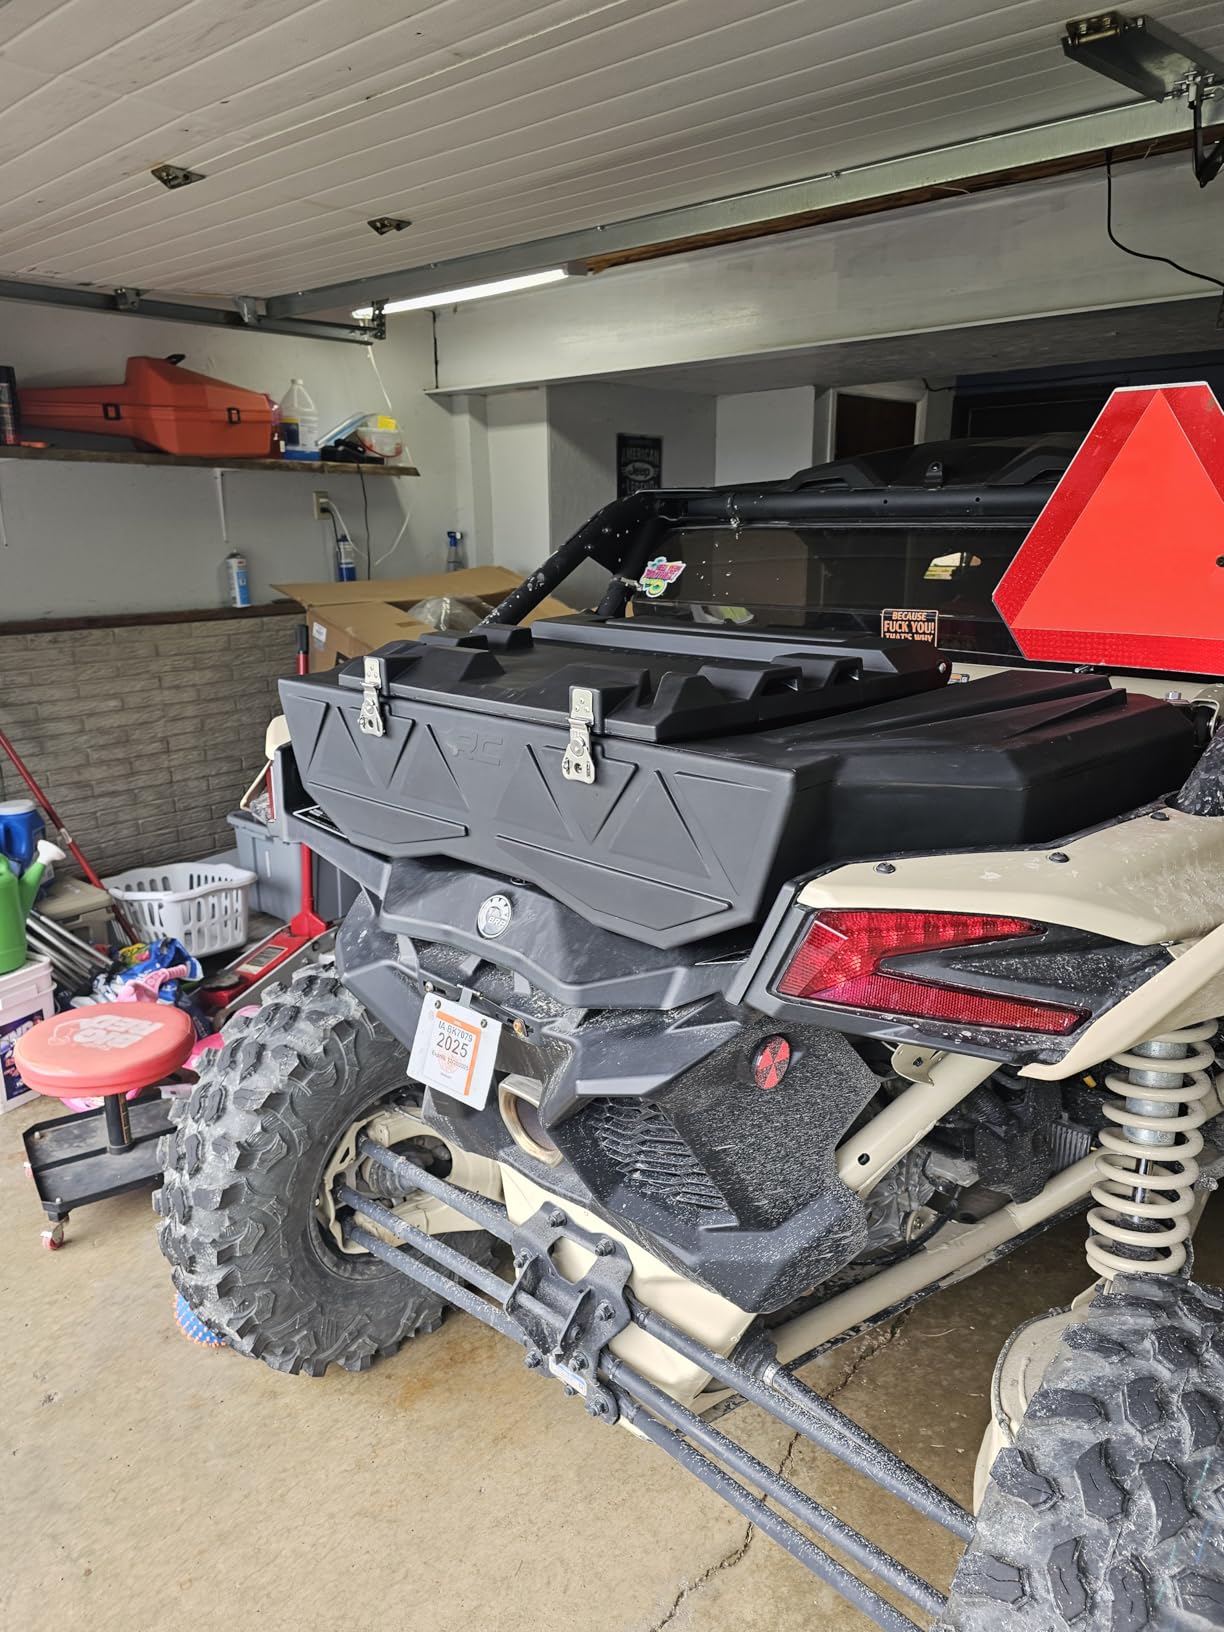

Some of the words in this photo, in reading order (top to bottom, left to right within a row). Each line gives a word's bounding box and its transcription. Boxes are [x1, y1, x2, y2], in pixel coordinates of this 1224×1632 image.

[621, 446, 660, 463] AMERICAN
[627, 463, 653, 479] Jeep
[892, 611, 927, 621] BECAUSE
[883, 620, 909, 632] FUCK
[910, 621, 935, 634] YOU!
[914, 633, 933, 643] WHY
[488, 916, 507, 928] BRP
[438, 1020, 446, 1031] IA
[436, 1032, 469, 1058] 2025
